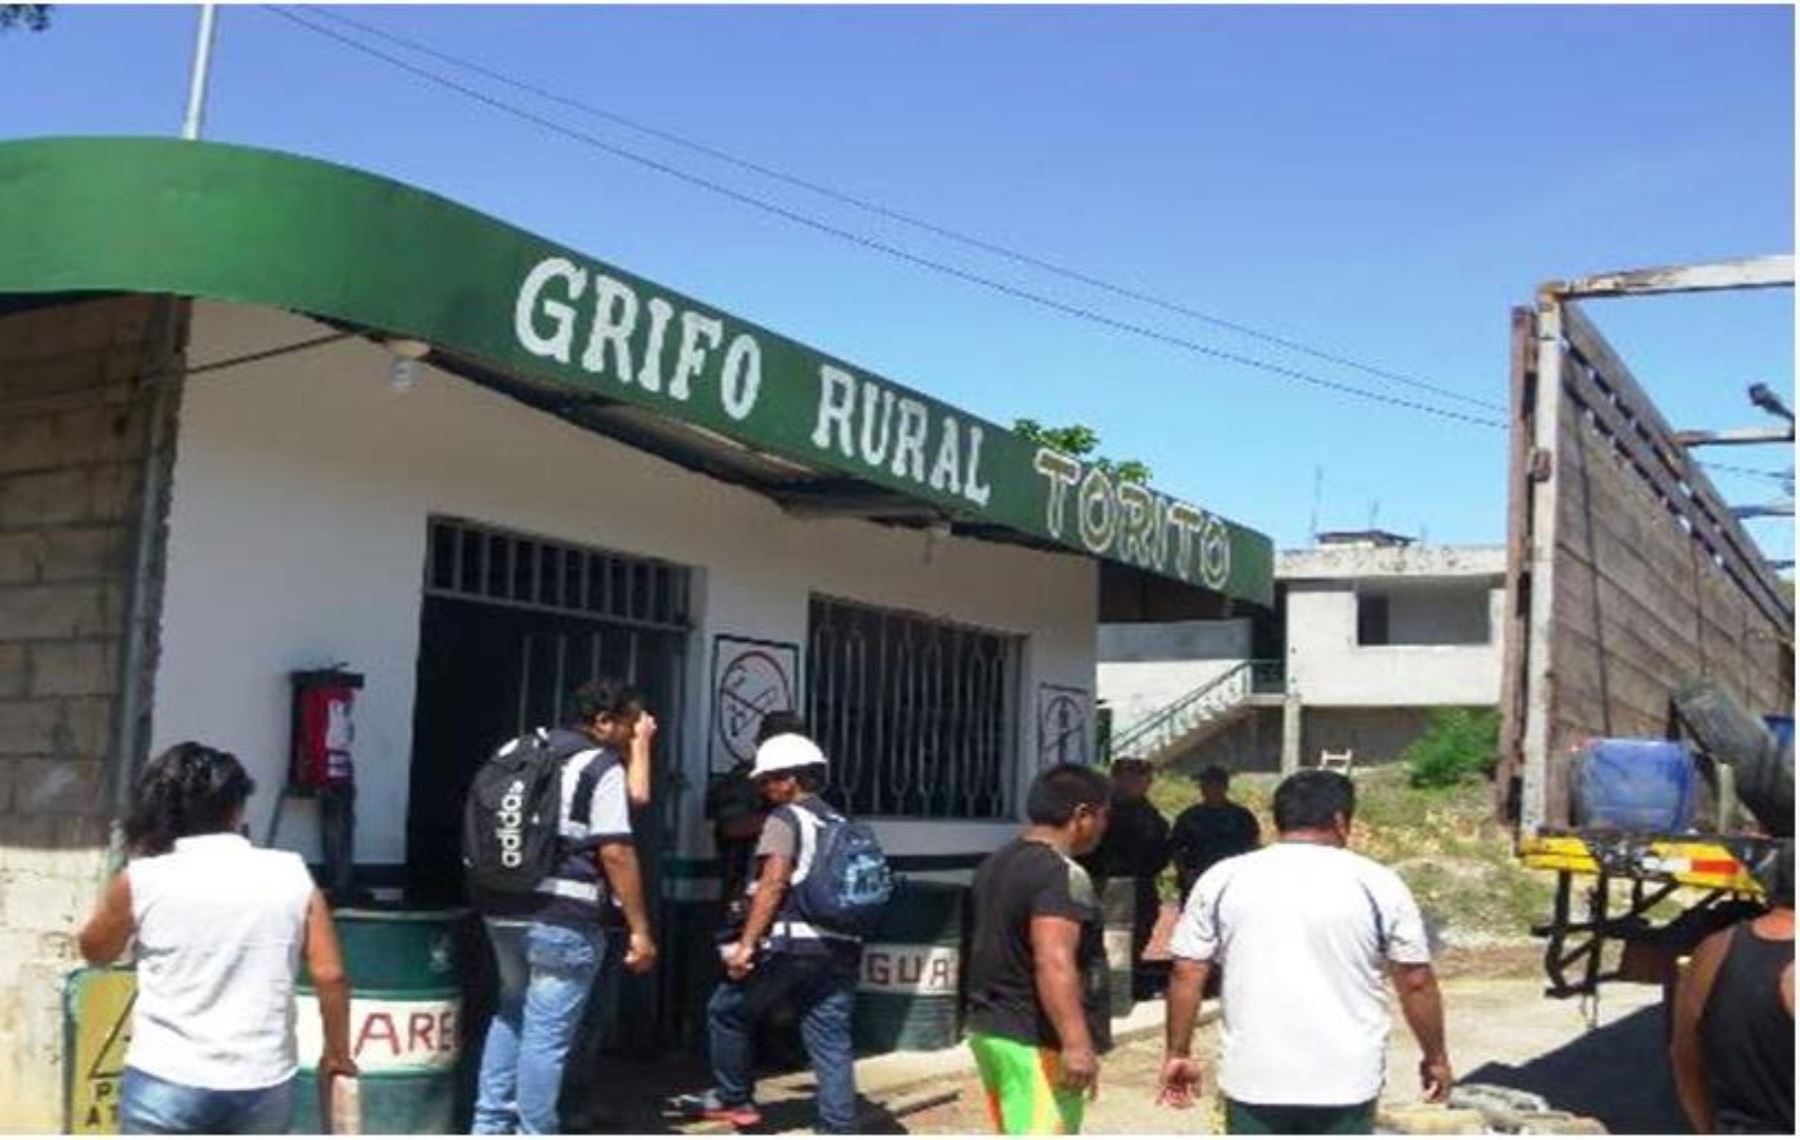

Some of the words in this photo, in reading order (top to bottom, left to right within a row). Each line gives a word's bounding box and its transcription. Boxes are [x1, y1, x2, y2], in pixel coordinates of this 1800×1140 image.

[515, 257, 762, 420] GRIFO
[811, 364, 991, 507] RURAL
[1034, 448, 1231, 590] TORITO
[496, 780, 524, 868] adidas
